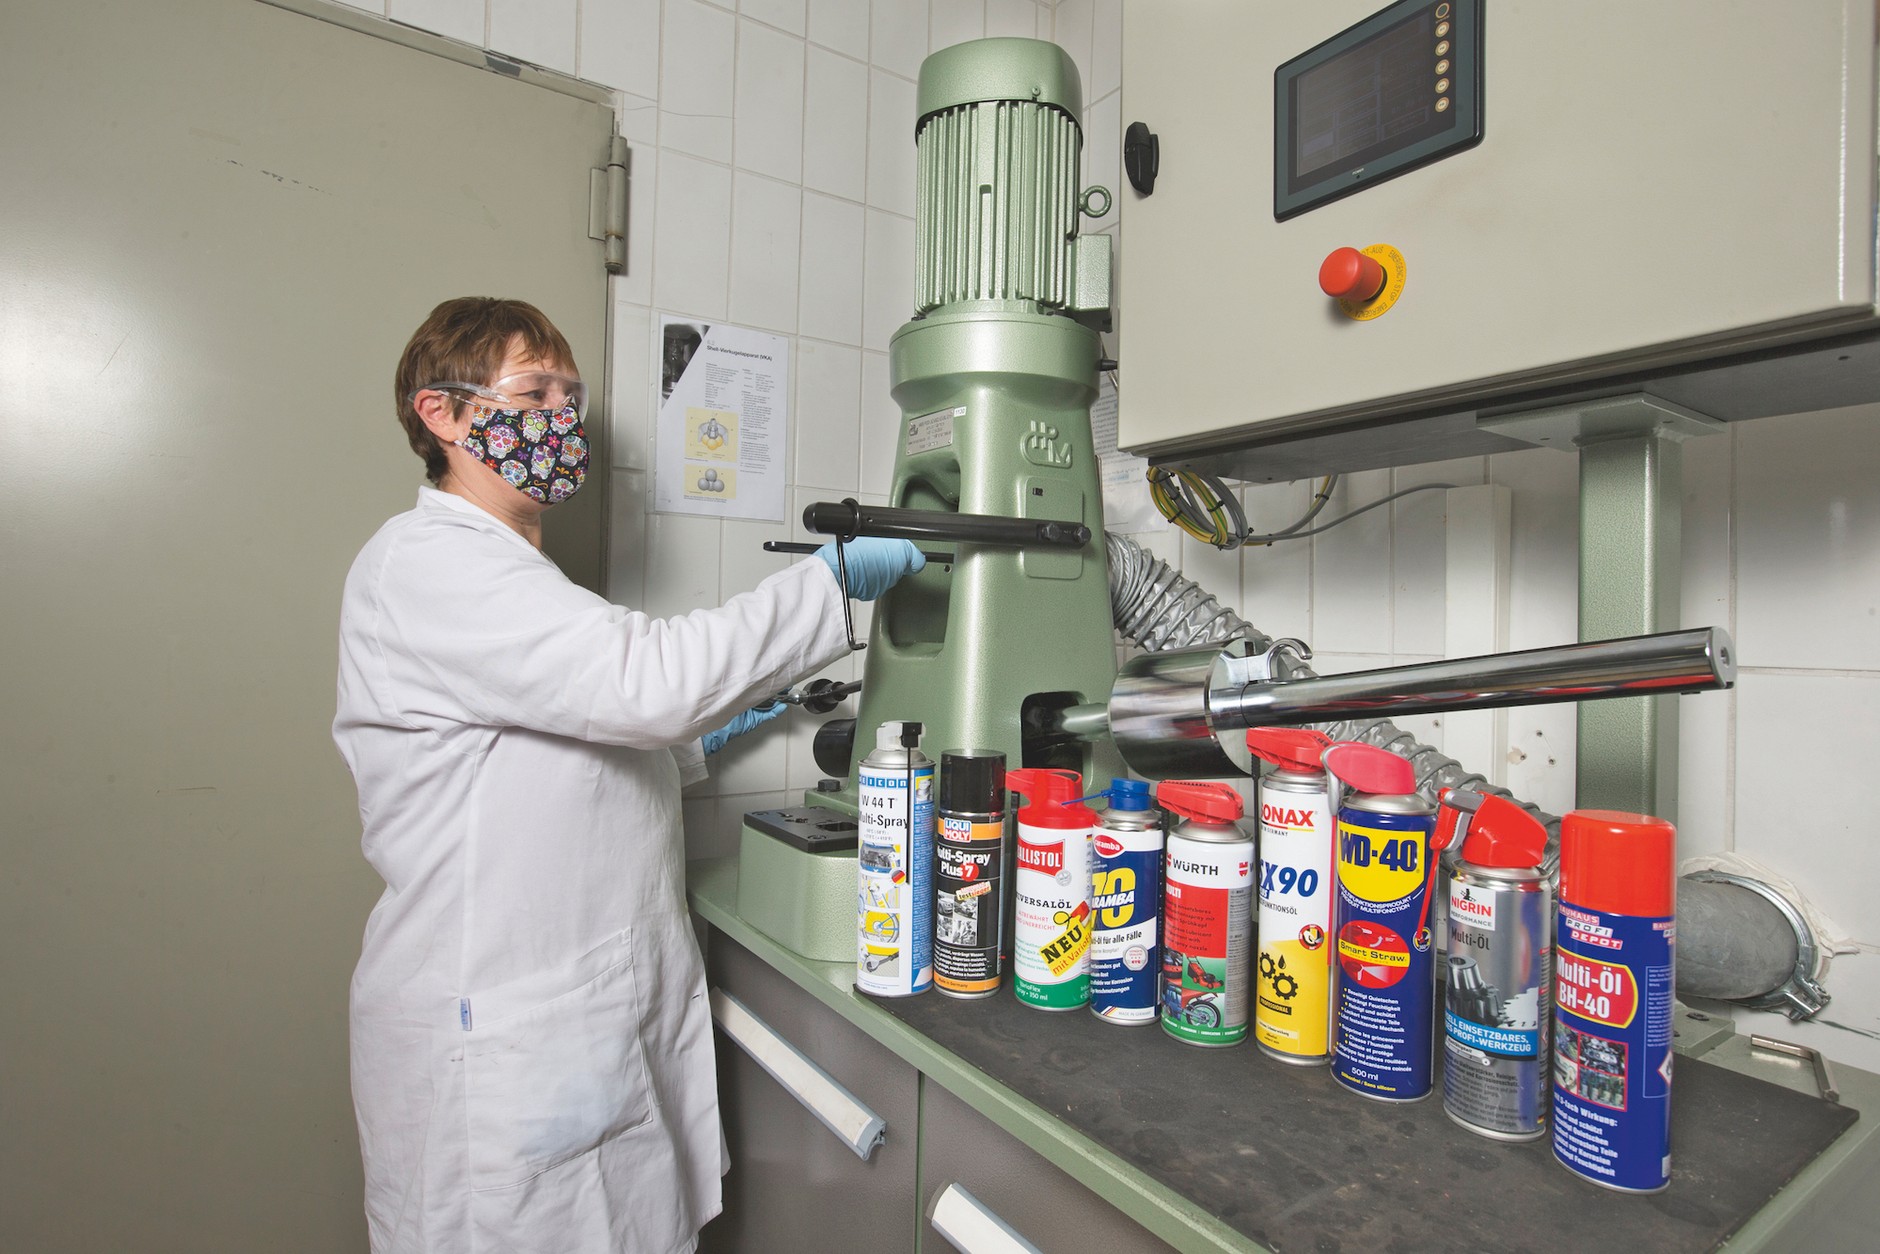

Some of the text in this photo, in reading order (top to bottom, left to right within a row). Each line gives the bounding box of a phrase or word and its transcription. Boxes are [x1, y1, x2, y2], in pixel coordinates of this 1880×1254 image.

[1390, 284, 1402, 302] STOP
[862, 794, 895, 809] W 44 T
[945, 820, 970, 831] LIQUI
[1267, 829, 1288, 837] GERMANY
[945, 830, 970, 841] MOLY
[1340, 830, 1418, 872] WD-40
[941, 861, 974, 878] Plus 7
[1173, 858, 1219, 876] WÜRTH
[1340, 884, 1412, 909] MULTIFUNKTIONSPRODUKT
[1341, 891, 1411, 915] PRODUIT MULTIFONCTION
[1451, 895, 1491, 917] NIGRIN
[1451, 911, 1492, 927] PERFORMANCE
[1567, 918, 1609, 936] PROFI
[1041, 925, 1083, 964] NEU
[1103, 930, 1142, 944] für alle Fälle
[1451, 926, 1490, 950] Multi-Öl
[1571, 930, 1620, 948] DEPOT
[1340, 941, 1367, 957] Smart
[1370, 951, 1405, 962] Straw
[1052, 960, 1069, 975] mit
[1557, 954, 1622, 996] Multi-Öl
[1111, 977, 1133, 985] Korrosion
[1346, 995, 1400, 1012] Verdrängt Feuchtigkeit
[1347, 988, 1398, 1004] Beseitigt Quietschen
[1560, 980, 1610, 1019] BH-40
[1344, 1007, 1360, 1018] Lockert
[1361, 1014, 1387, 1024] verrostete
[1348, 1003, 1364, 1012] Reinigt
[1342, 1023, 1361, 1036] Supprime
[1371, 1034, 1404, 1043] grincements
[1350, 1016, 1379, 1030] festsitzende
[1379, 1025, 1405, 1033] Mechanik
[1458, 1021, 1529, 1044] EINSETZBARES,
[1348, 1040, 1365, 1051] Nettoie
[1372, 1049, 1393, 1057] protège
[1349, 1034, 1394, 1050] Chasse l'humidité
[1453, 1028, 1532, 1052] PROFI-WERKZEUG
[1358, 1059, 1391, 1071] mécanismes
[1391, 1064, 1412, 1072] coincés
[1366, 1054, 1383, 1063] pièces
[1351, 1067, 1378, 1081] 500 ml
[1364, 1081, 1376, 1089] Sans
[1376, 1084, 1396, 1092] silicone
[1568, 1114, 1579, 1124] und
[1579, 1121, 1603, 1135] schützt
[1580, 1107, 1618, 1127] Wirkung:
[1573, 1126, 1609, 1146] Quietschen
[1568, 1135, 1599, 1153] verrostete
[1600, 1146, 1618, 1158] Teile
[1568, 1144, 1578, 1153] vor
[1578, 1148, 1611, 1166] Korrosion
[1574, 1155, 1616, 1177] Feuchtigkeit
